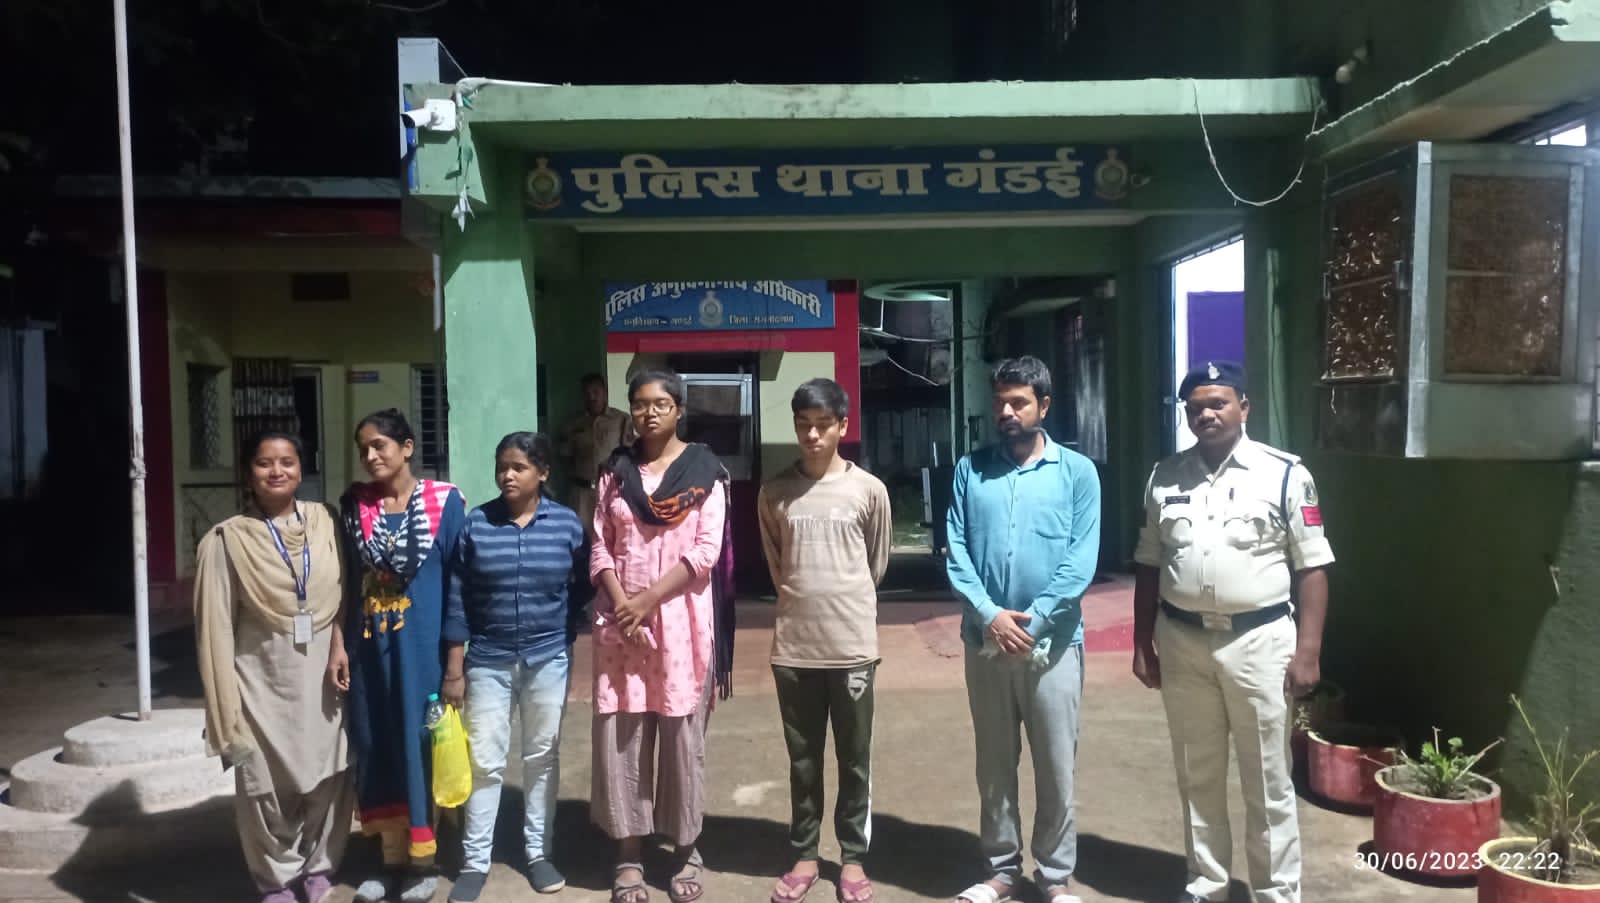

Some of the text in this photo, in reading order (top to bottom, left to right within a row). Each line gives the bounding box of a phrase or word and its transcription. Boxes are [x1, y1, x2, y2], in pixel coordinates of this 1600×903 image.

[571, 147, 1083, 213] पुलिस थाना गंडई
